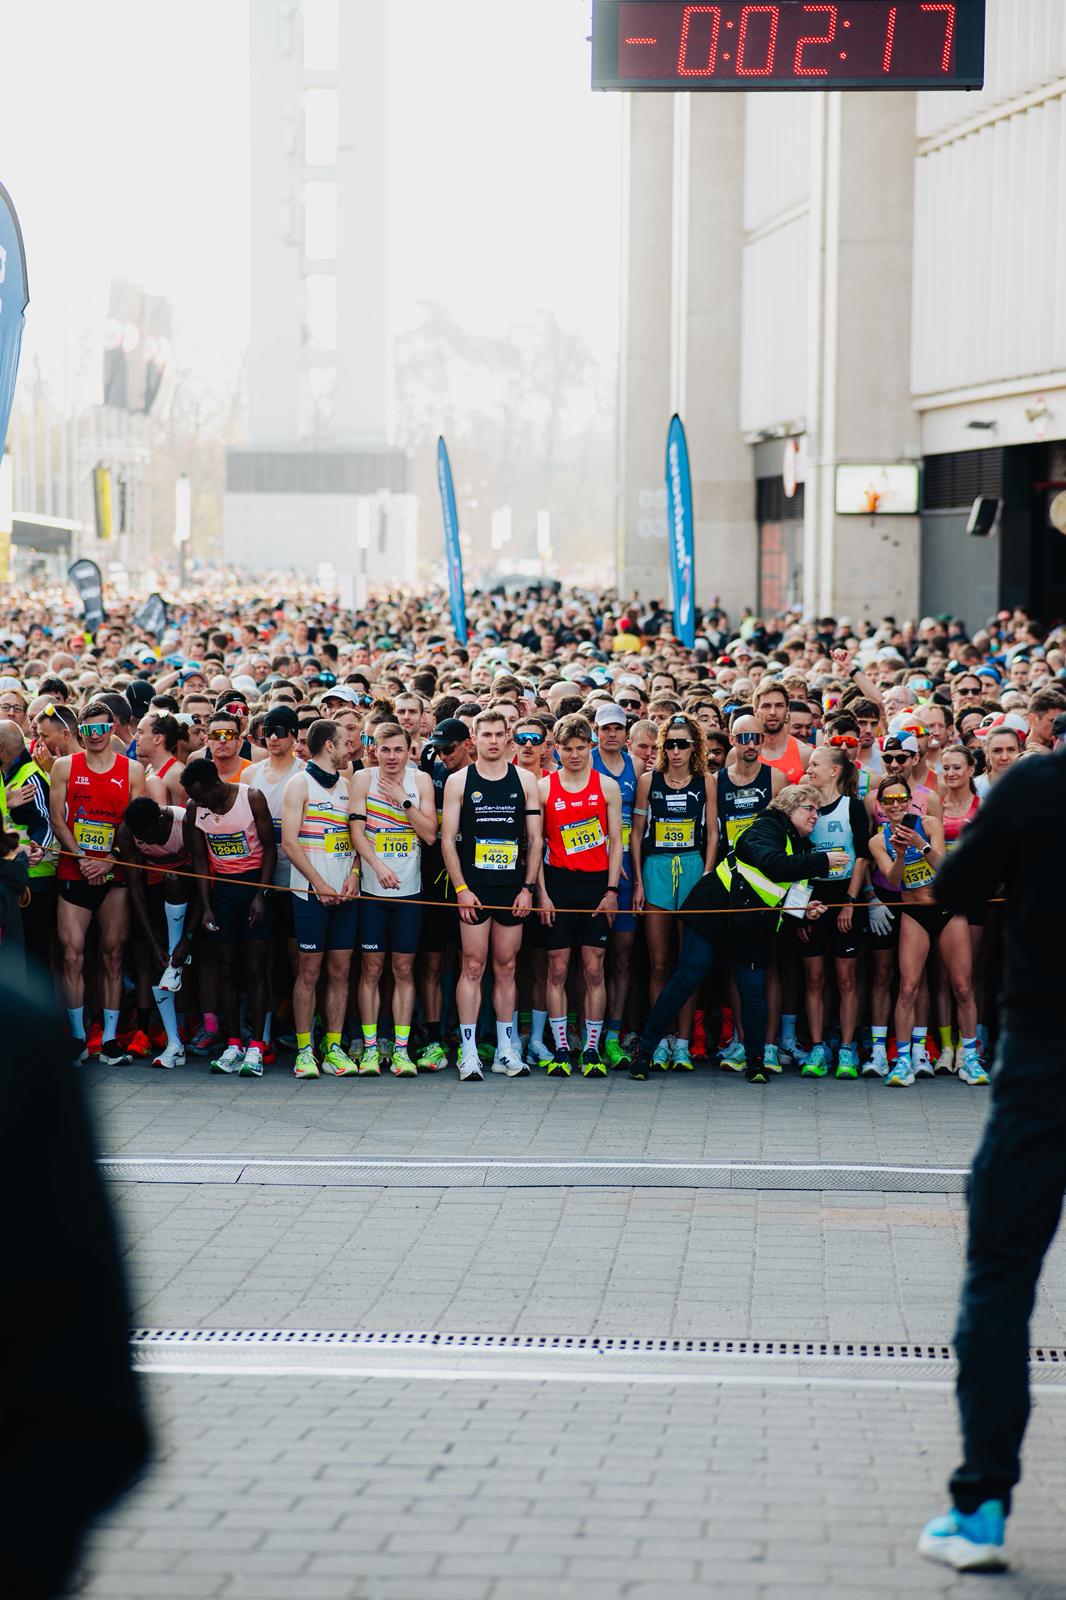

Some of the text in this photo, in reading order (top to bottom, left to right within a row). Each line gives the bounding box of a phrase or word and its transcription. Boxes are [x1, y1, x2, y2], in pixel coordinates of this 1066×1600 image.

[79, 833, 105, 845] 1340
[570, 832, 596, 846] 1191
[664, 831, 684, 842] 439
[334, 841, 350, 851] 490
[382, 842, 409, 852] 1106
[588, 841, 599, 849] GLS
[482, 854, 509, 864] 1423
[905, 868, 932, 883] 1374
